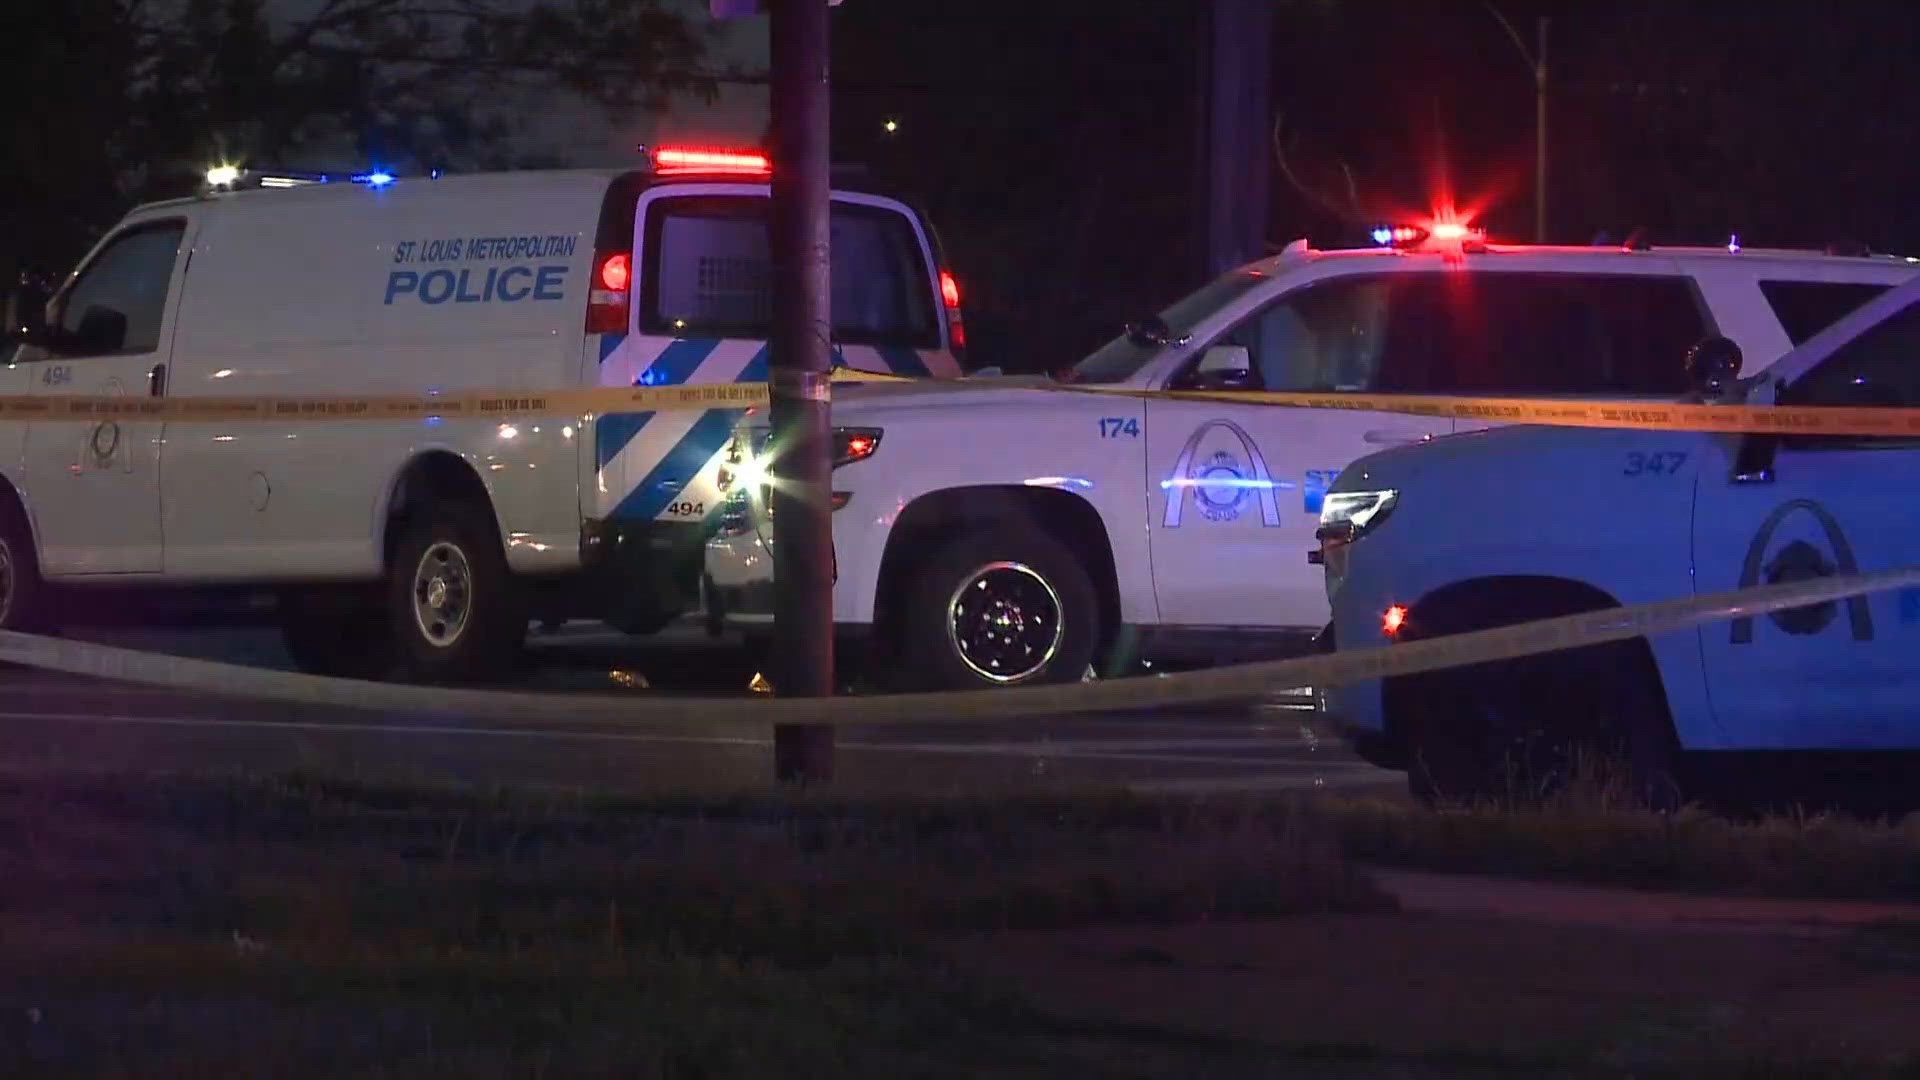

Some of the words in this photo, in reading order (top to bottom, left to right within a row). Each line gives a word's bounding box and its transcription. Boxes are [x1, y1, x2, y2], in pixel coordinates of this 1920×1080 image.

[394, 240, 416, 264] ST.
[420, 238, 463, 262] LOUIS
[465, 235, 577, 261] METROPOLITAN
[383, 265, 570, 306] POLICE
[42, 366, 72, 386] 494
[1098, 417, 1140, 438] 174
[1623, 452, 1688, 476] 347
[668, 502, 705, 516] 494
